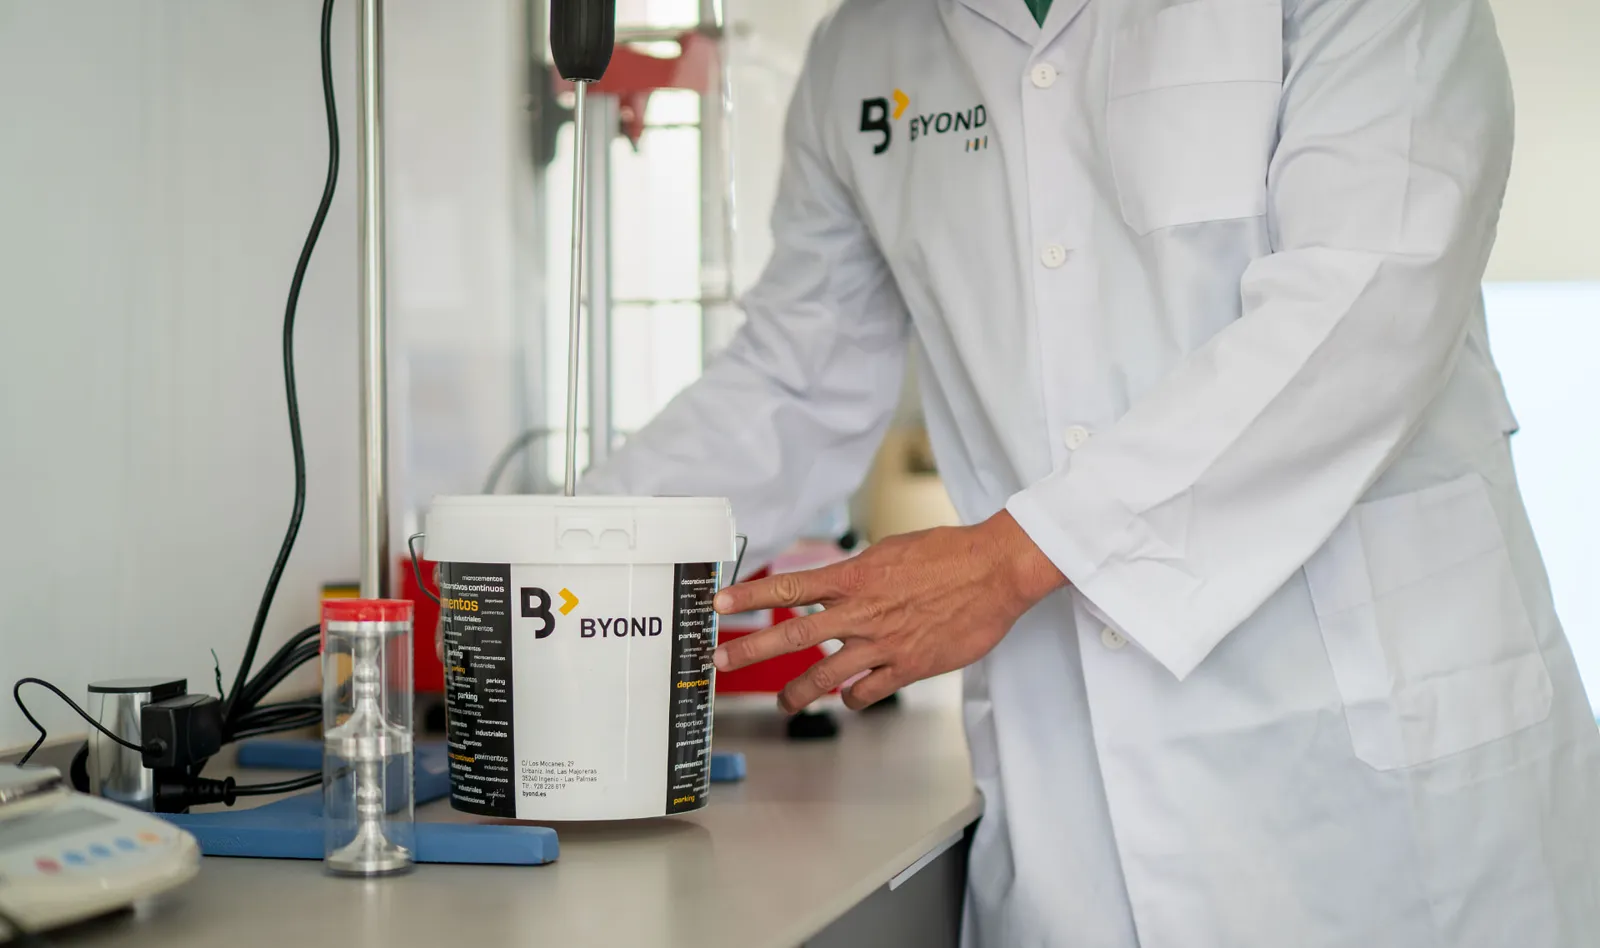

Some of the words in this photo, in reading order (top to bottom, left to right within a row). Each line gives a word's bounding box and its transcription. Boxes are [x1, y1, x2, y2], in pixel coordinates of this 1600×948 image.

[910, 104, 987, 142] BYOND
[469, 584, 505, 593] contínuos
[454, 614, 482, 623] industriales
[580, 617, 663, 638] BYOND
[679, 632, 701, 641] parking
[486, 678, 506, 686] parking
[458, 692, 478, 703] parking
[675, 720, 704, 728] deportivos
[475, 729, 508, 738] industriales
[676, 738, 703, 748] pavimentos
[474, 753, 509, 763] pavimentos
[675, 760, 703, 771] pavimentos
[674, 796, 695, 805] parking
